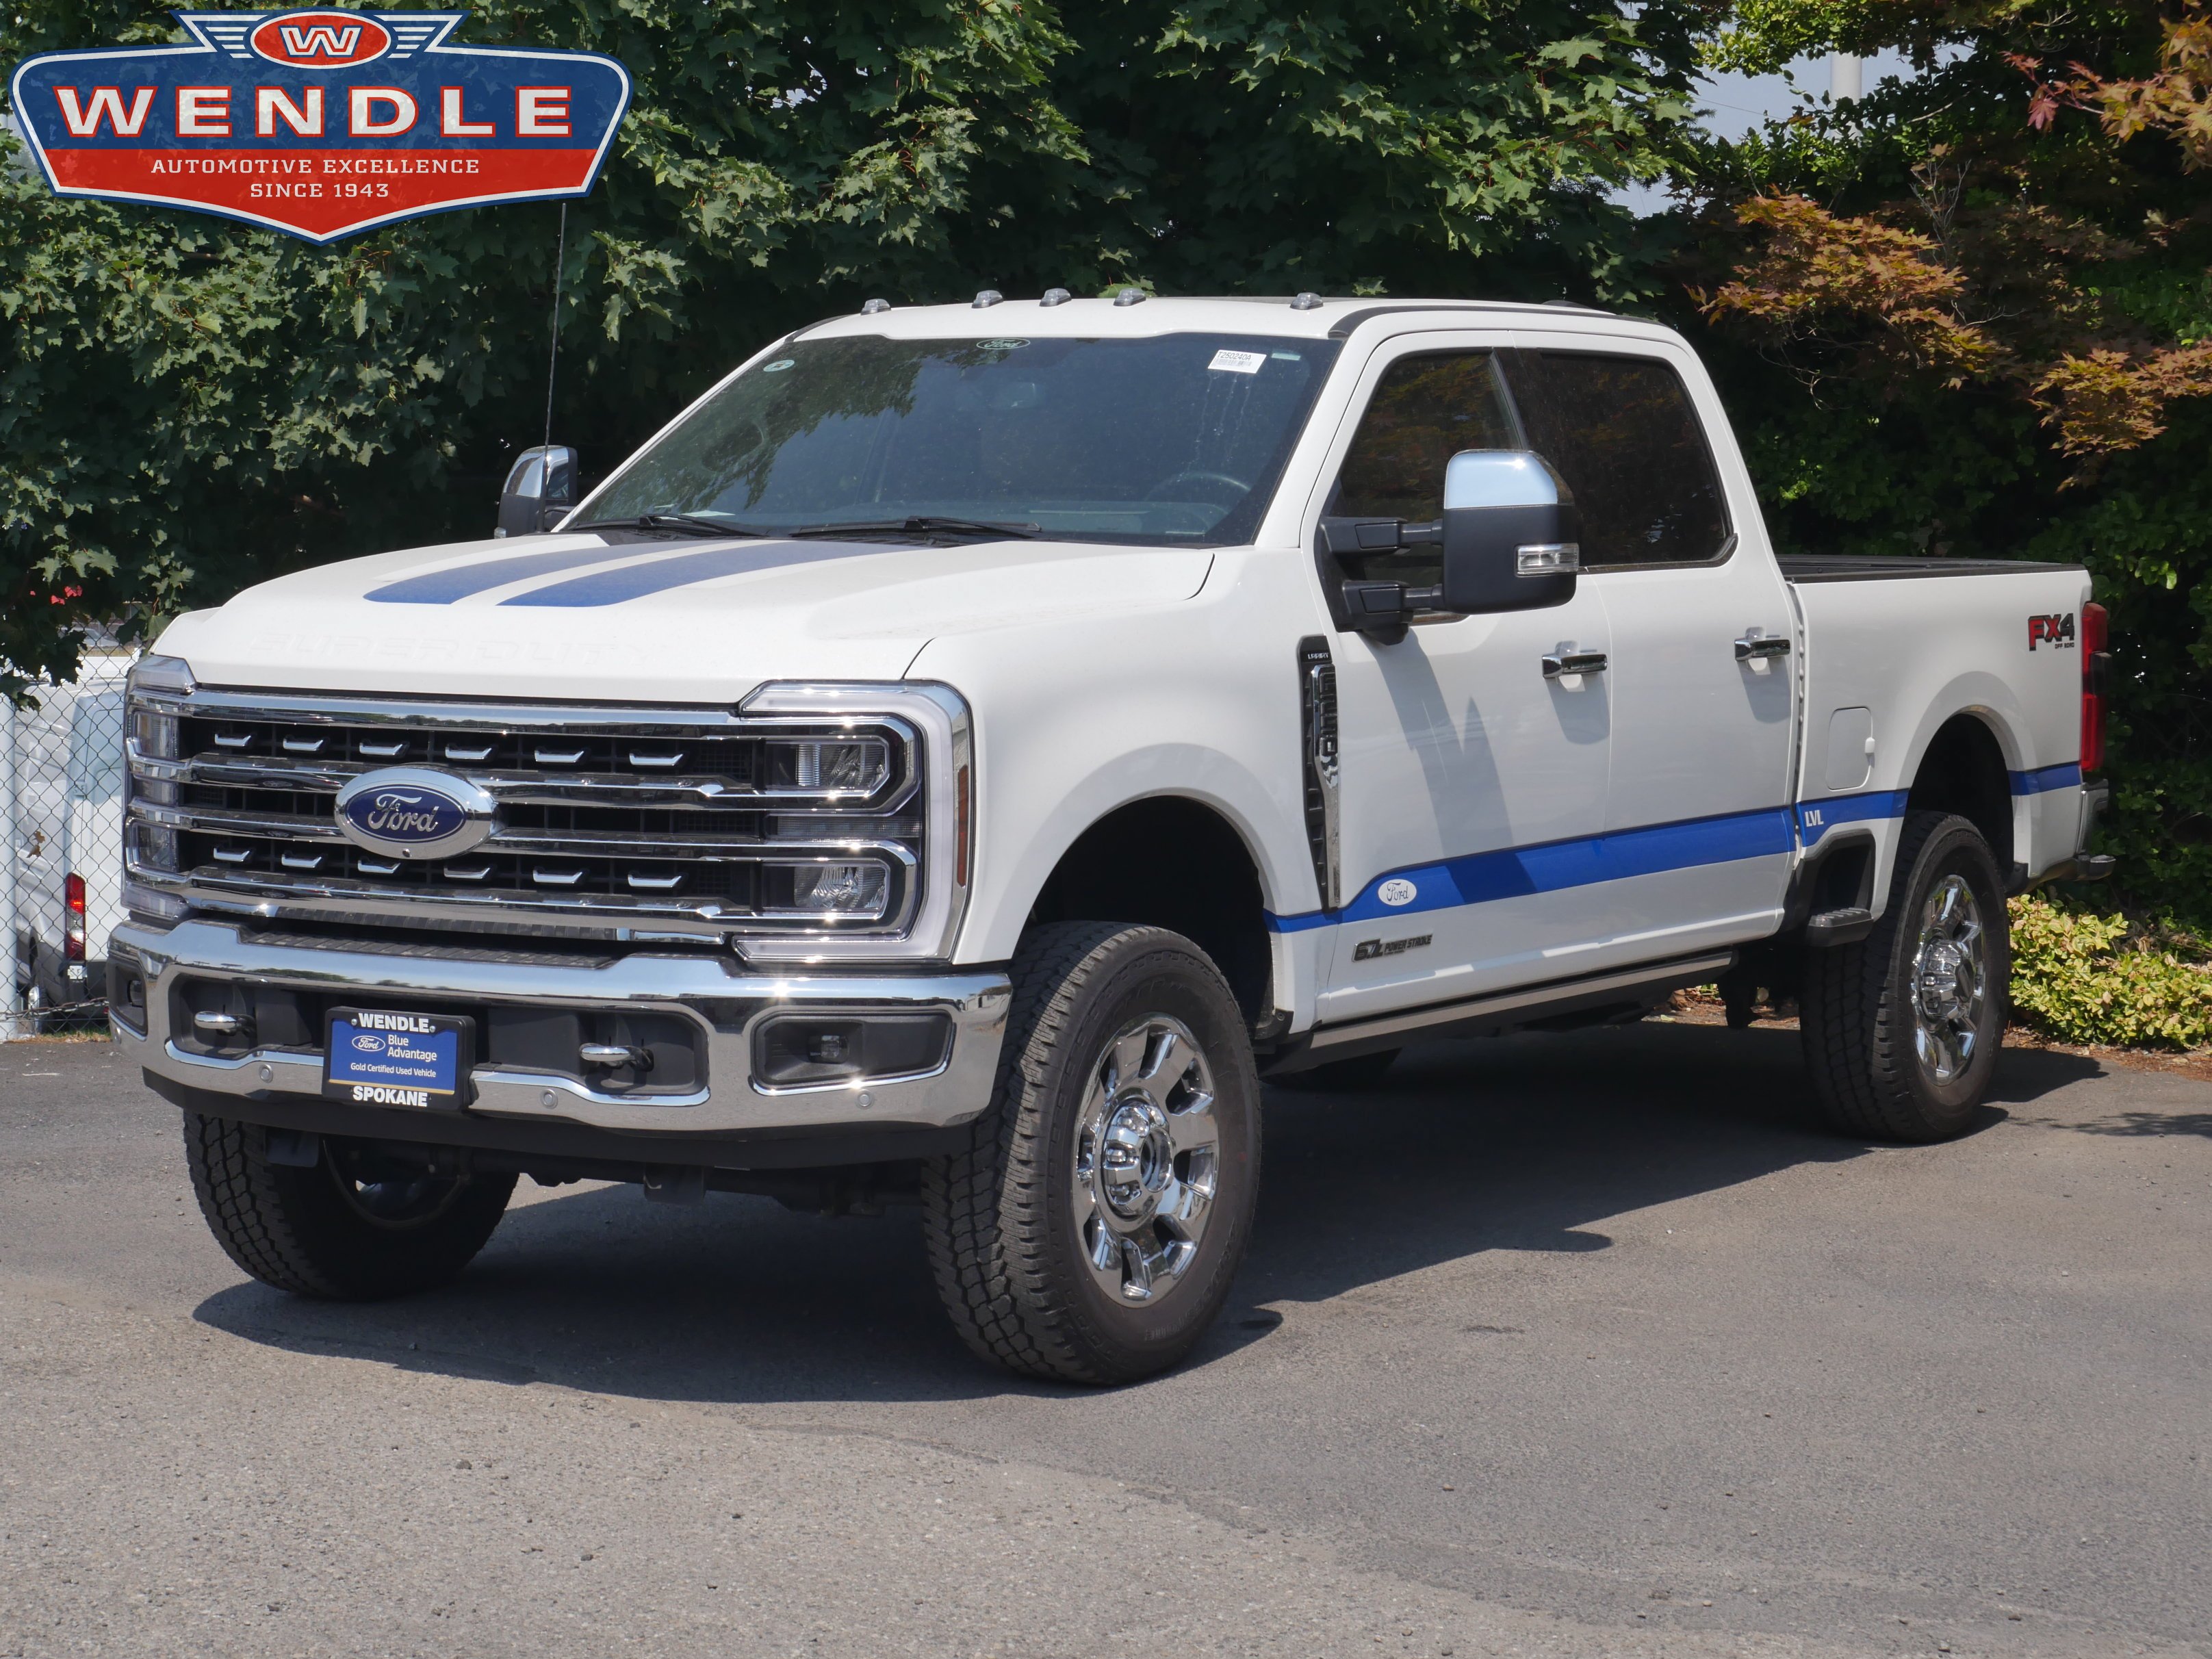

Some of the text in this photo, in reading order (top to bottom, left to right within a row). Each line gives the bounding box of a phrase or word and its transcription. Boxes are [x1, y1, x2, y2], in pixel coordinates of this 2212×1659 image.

[983, 339, 1022, 348] Ford
[2028, 613, 2074, 652] FX4
[368, 793, 439, 832] Ford
[1804, 809, 1824, 827] LVL
[1387, 882, 1409, 901] Ford
[358, 1013, 430, 1033] WENDLE
[358, 1037, 379, 1050] Ford
[388, 1034, 409, 1046] Blue
[387, 1047, 437, 1062] Advantage
[350, 1062, 437, 1078] Gold Certified Used Vehicle
[352, 1085, 428, 1107] SPOKANE
